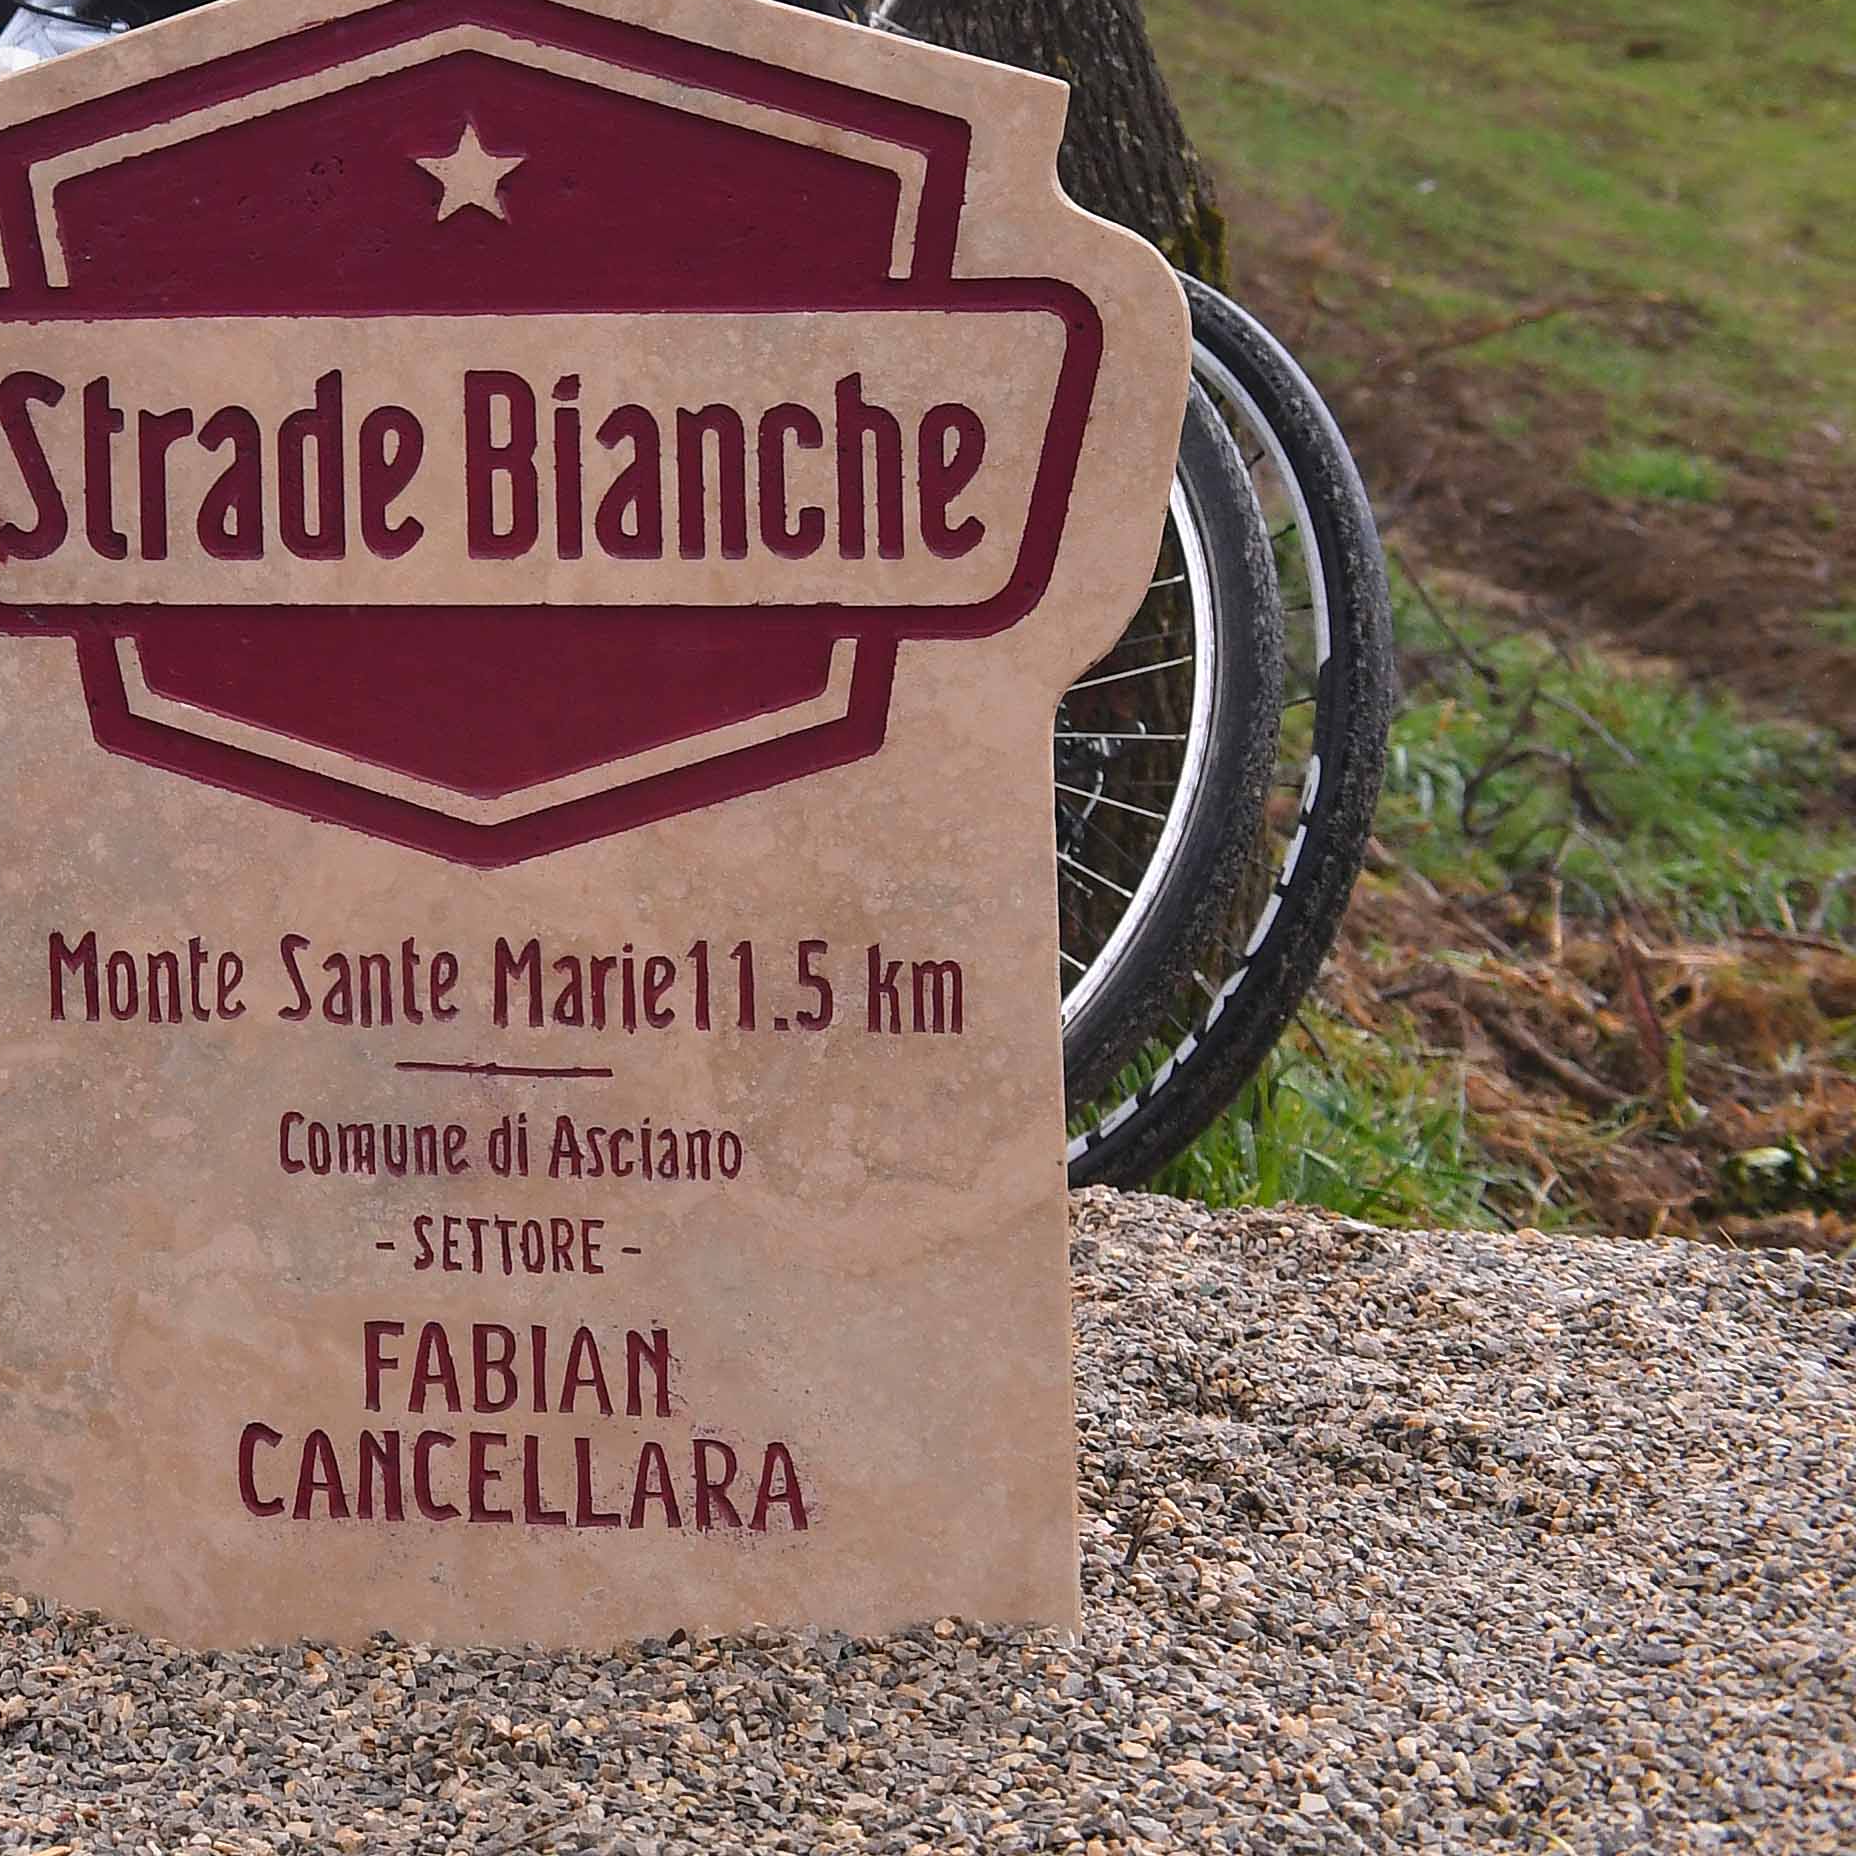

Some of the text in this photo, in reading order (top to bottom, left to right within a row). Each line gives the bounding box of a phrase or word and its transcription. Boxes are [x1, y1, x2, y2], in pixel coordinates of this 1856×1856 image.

[462, 369, 988, 562] Bianche
[48, 927, 249, 1025] Monte
[277, 932, 462, 1029] Sante
[863, 941, 965, 1036] km
[278, 1109, 744, 1182] Comune di Asciano
[363, 1320, 682, 1421] FABIAN
[237, 1421, 817, 1541] CANCELLARA
